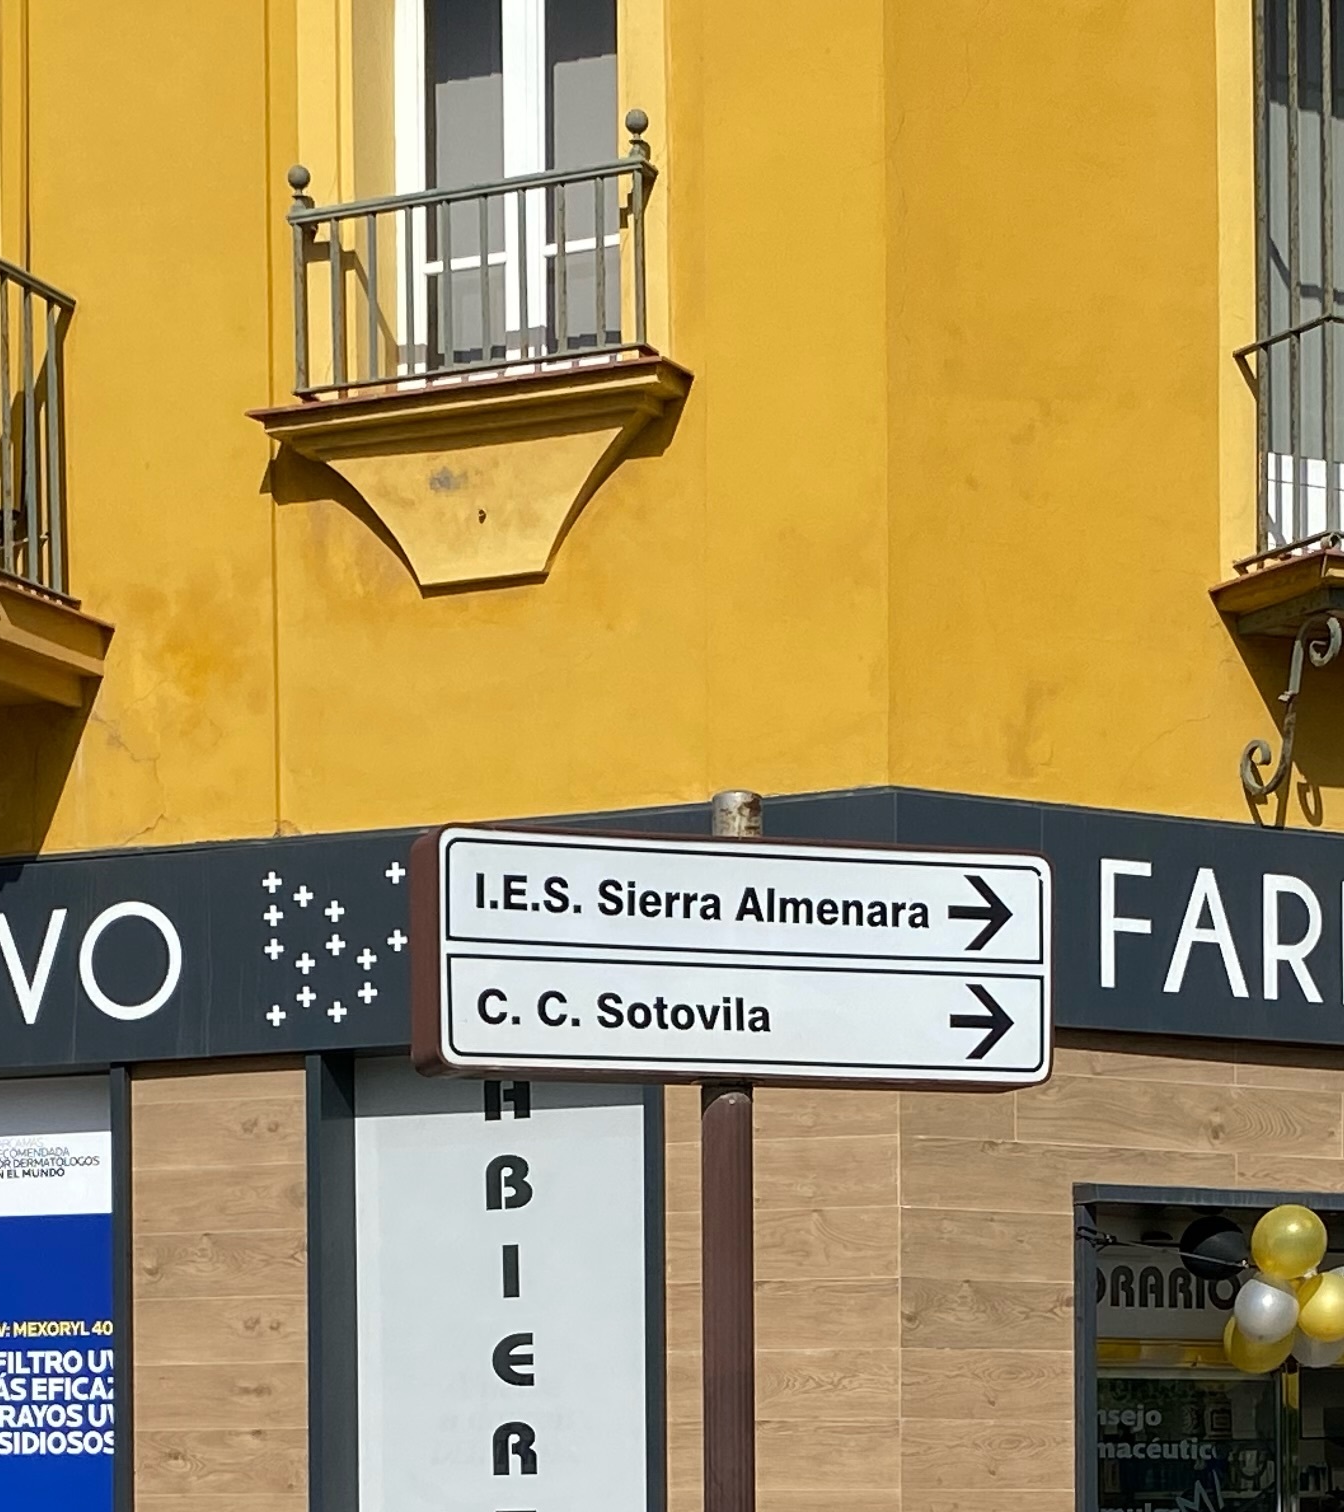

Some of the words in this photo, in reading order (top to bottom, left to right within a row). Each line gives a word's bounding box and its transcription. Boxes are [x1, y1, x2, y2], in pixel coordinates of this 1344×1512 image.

[475, 873, 582, 915] I.E.S.
[598, 879, 722, 922] Sierra
[735, 886, 931, 930] Almenara
[476, 988, 521, 1026] C.
[537, 990, 581, 1028] C.
[596, 992, 771, 1034] Sotovila
[7, 1170, 19, 1179] EL
[22, 1167, 65, 1179] MUNDO
[13, 1321, 90, 1337] MEXORYL
